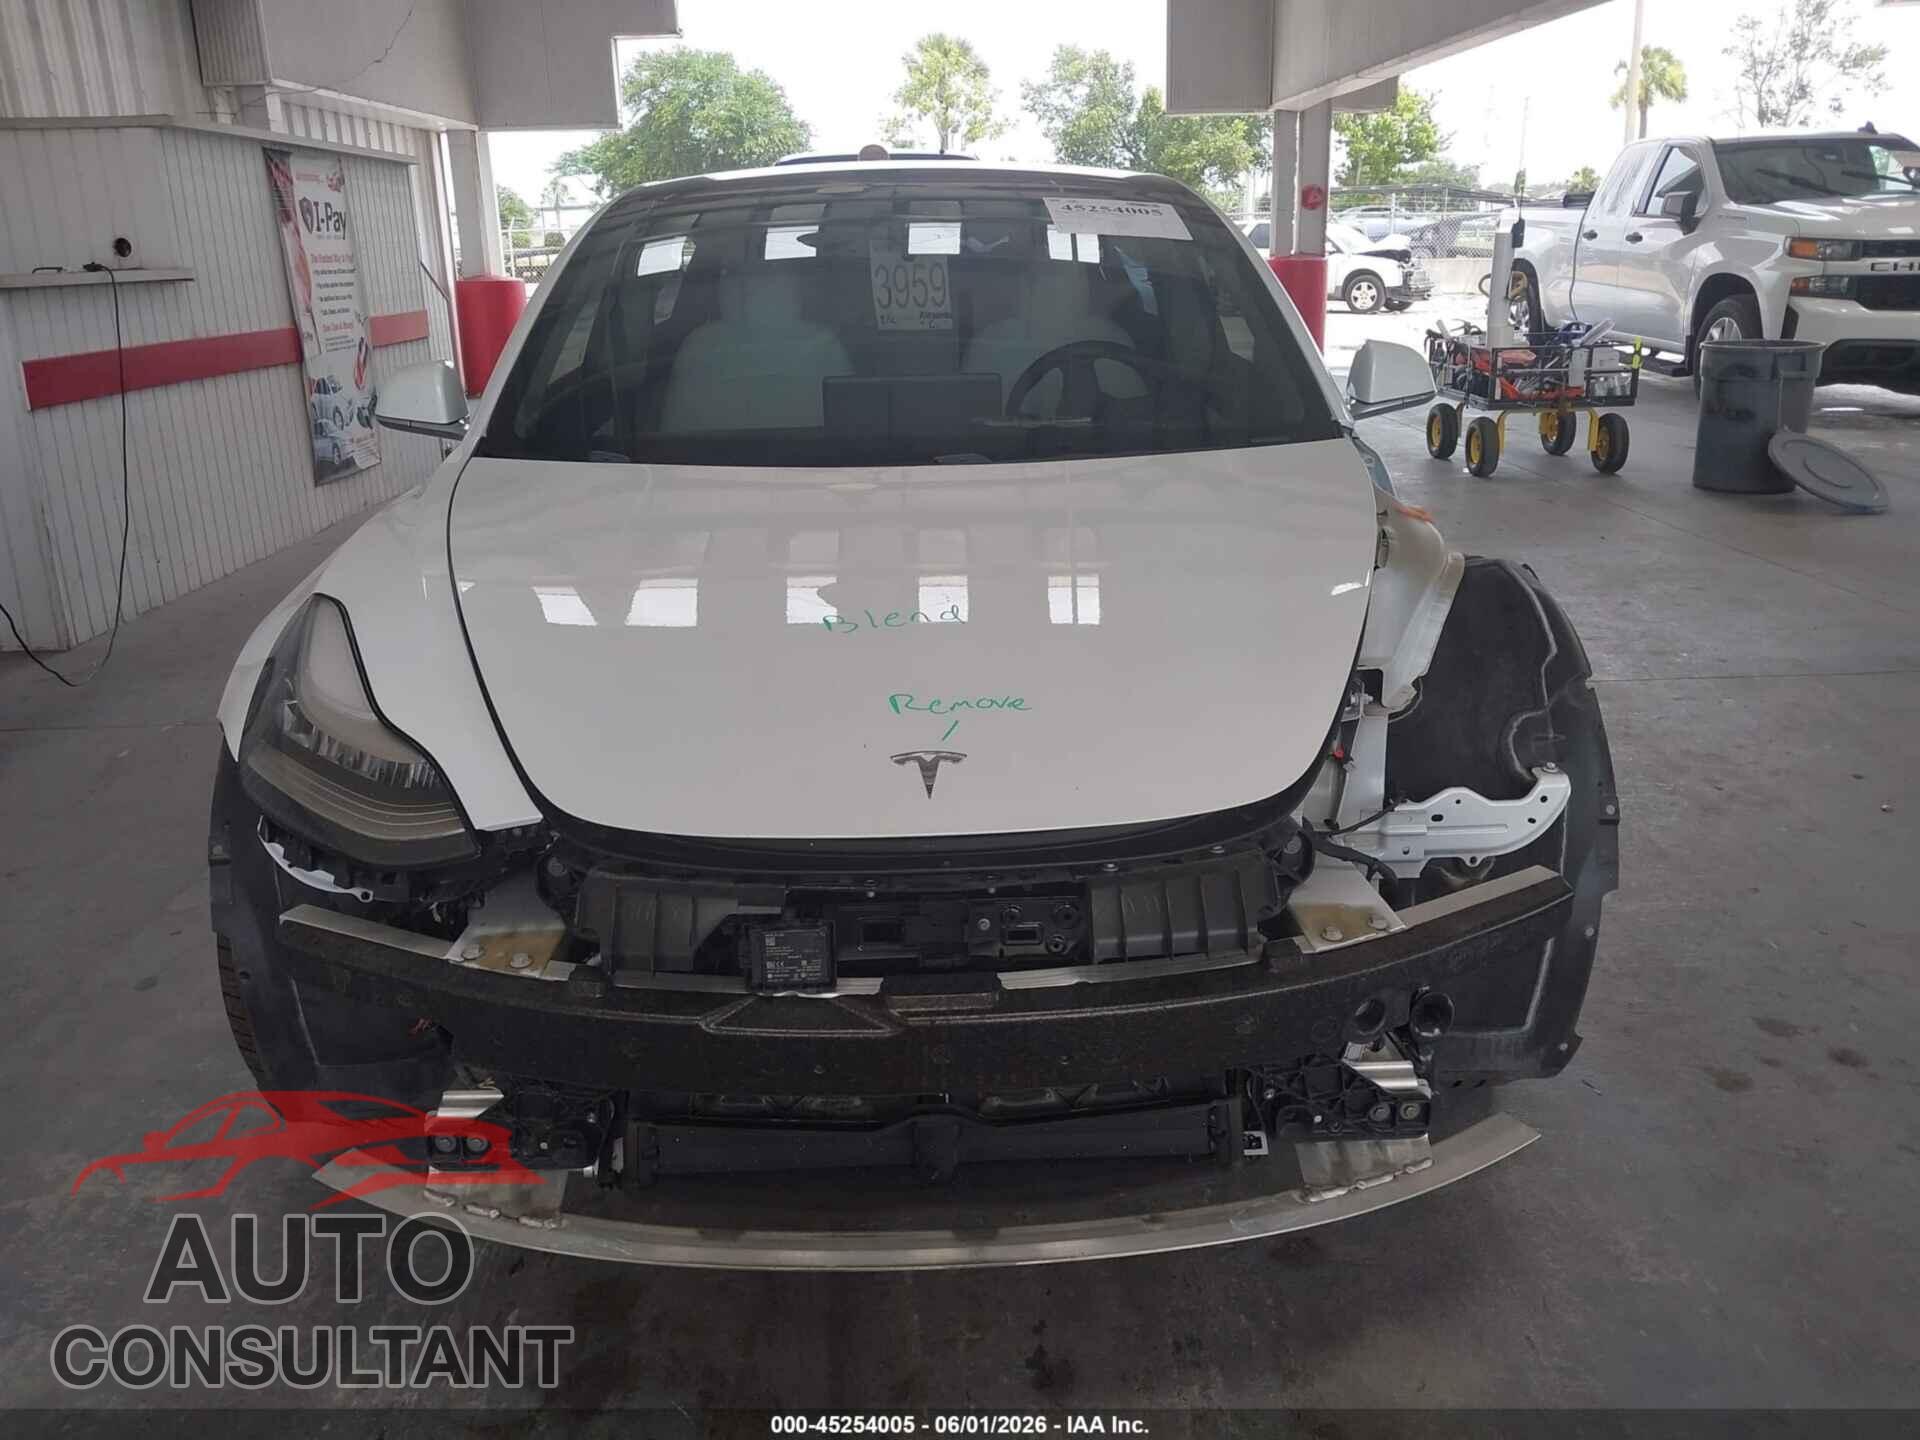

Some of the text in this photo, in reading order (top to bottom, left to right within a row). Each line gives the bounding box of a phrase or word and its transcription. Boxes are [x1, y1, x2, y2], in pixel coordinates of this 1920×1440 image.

[312, 201, 347, 240] I-Pay
[1060, 204, 1164, 217] 45254005
[1870, 261, 1920, 271] CH
[874, 262, 946, 309] 3959
[822, 604, 966, 634] Blend
[888, 694, 1033, 715] Remove
